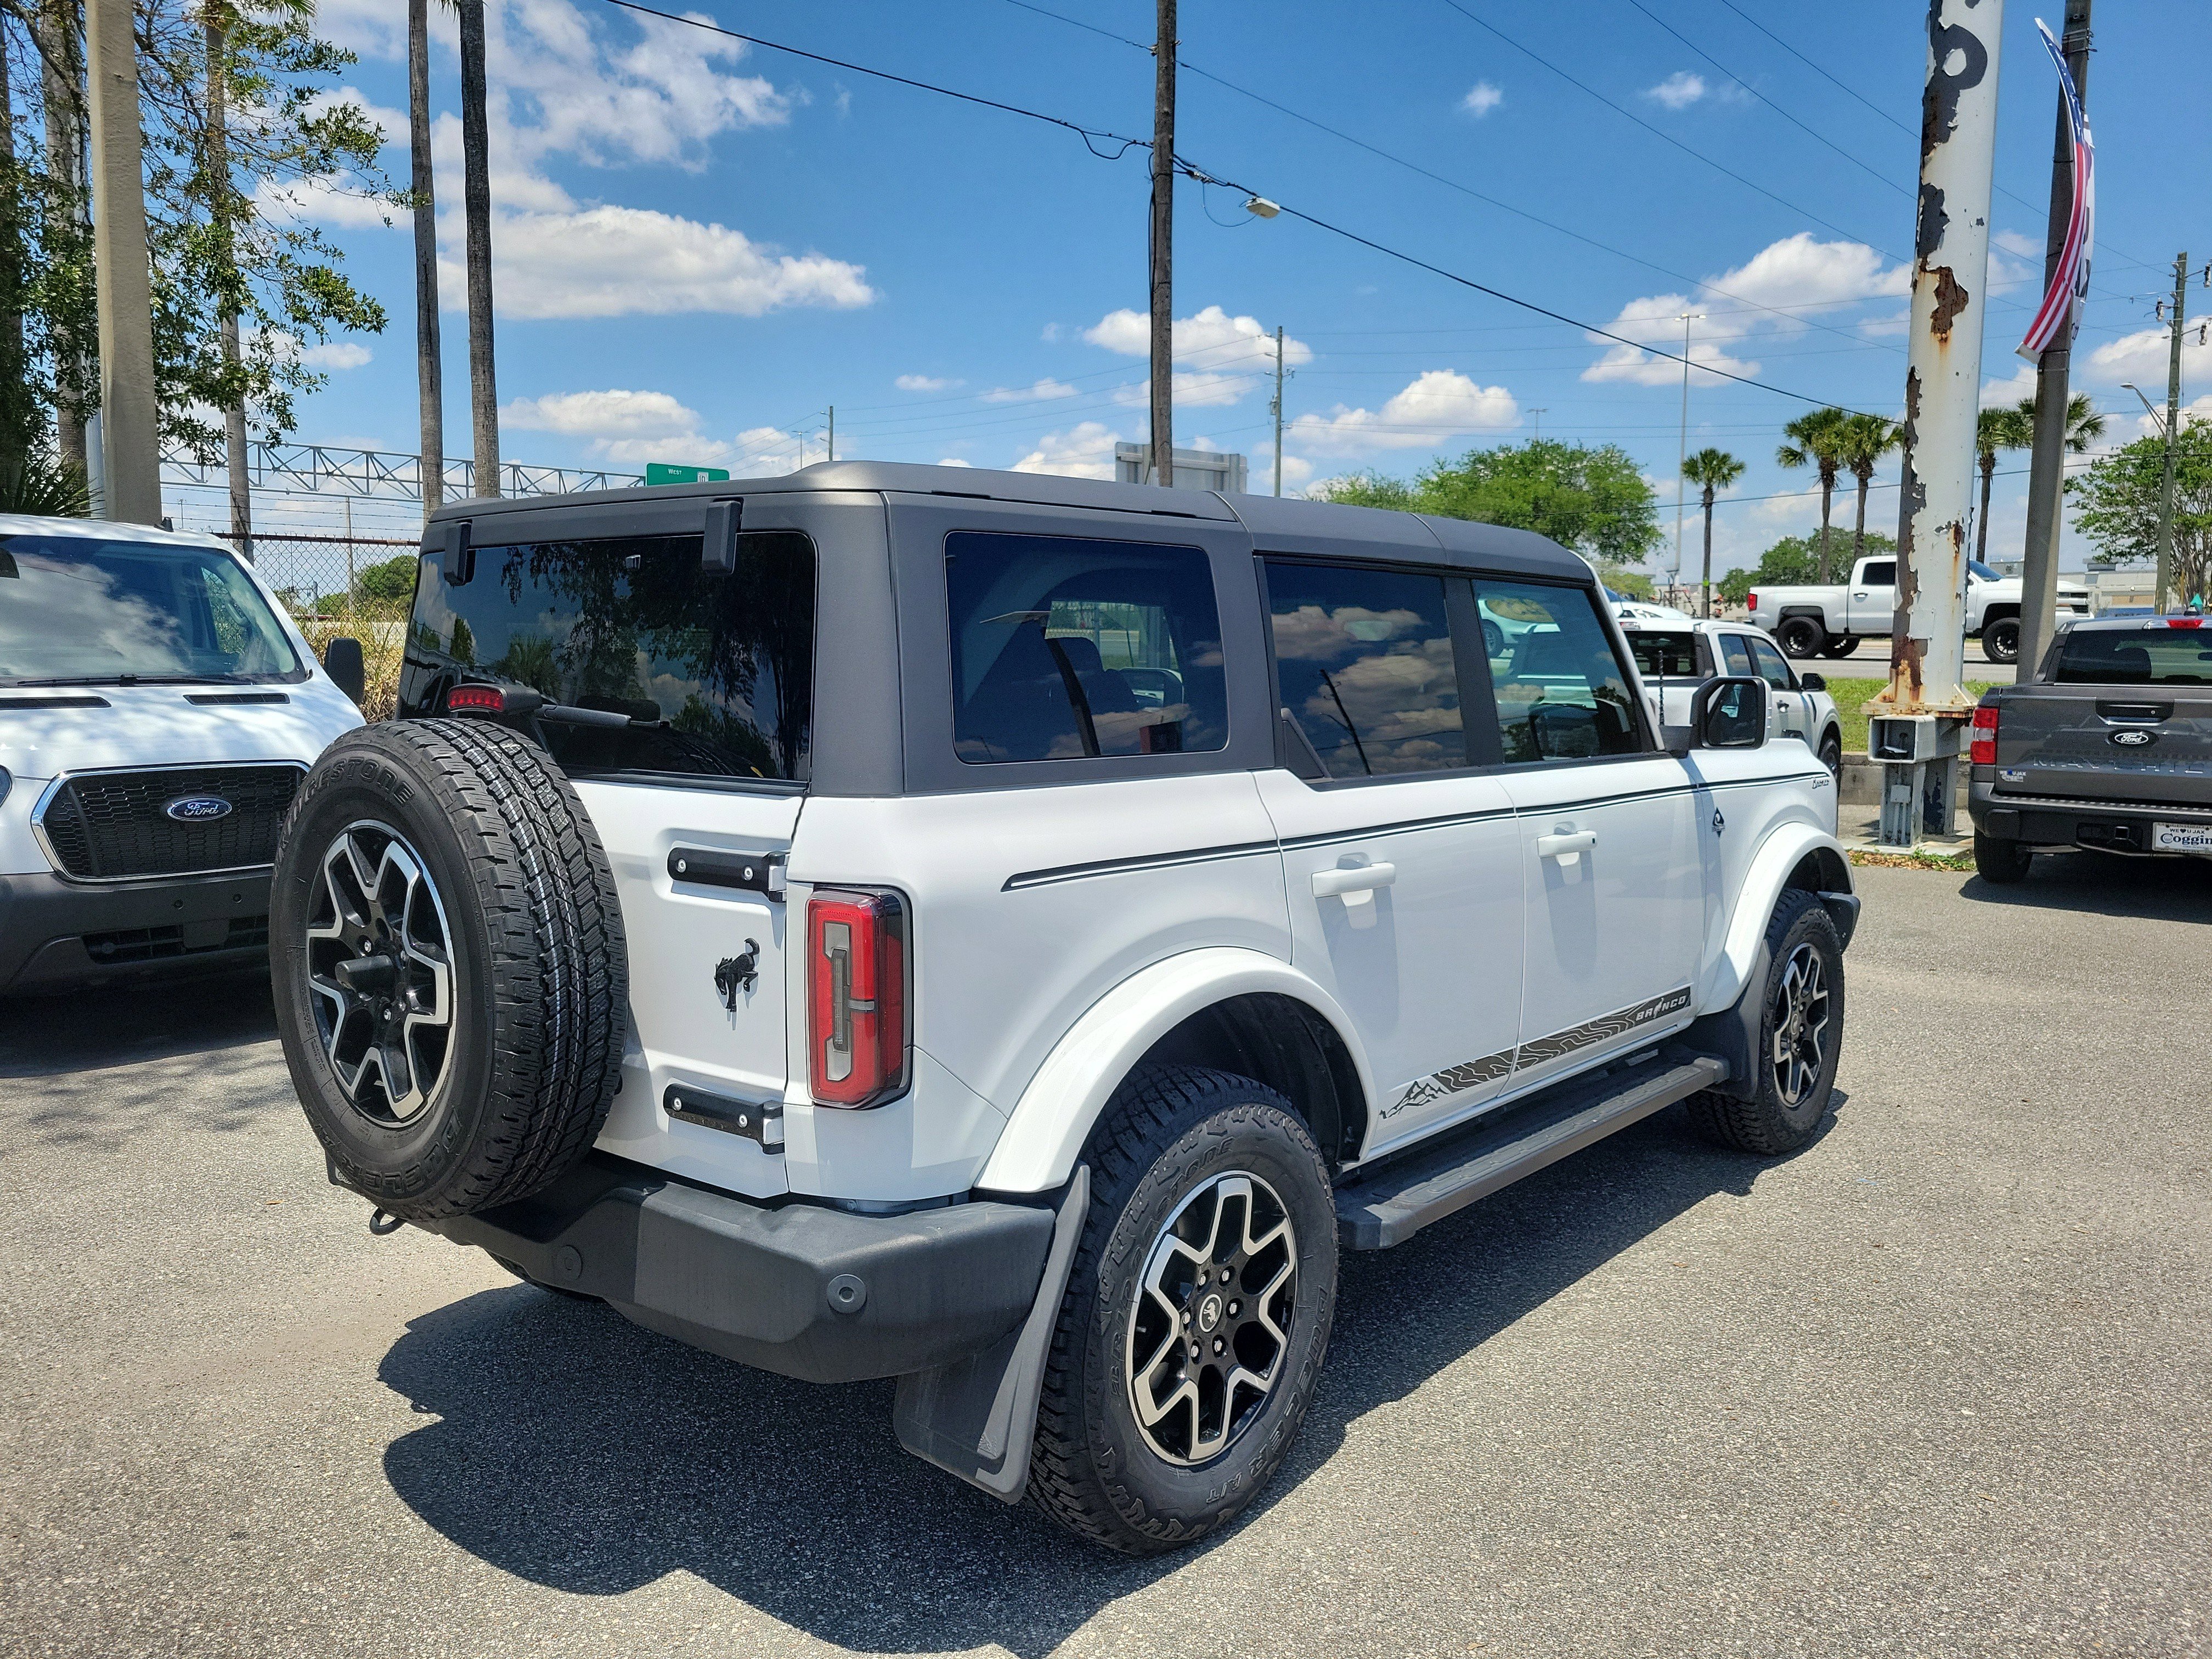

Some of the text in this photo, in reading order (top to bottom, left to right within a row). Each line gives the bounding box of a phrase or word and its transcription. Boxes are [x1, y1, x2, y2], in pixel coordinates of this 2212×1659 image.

[2120, 734, 2141, 743] Ford
[184, 802, 219, 816] Ford
[2160, 833, 2212, 846] Coggin
